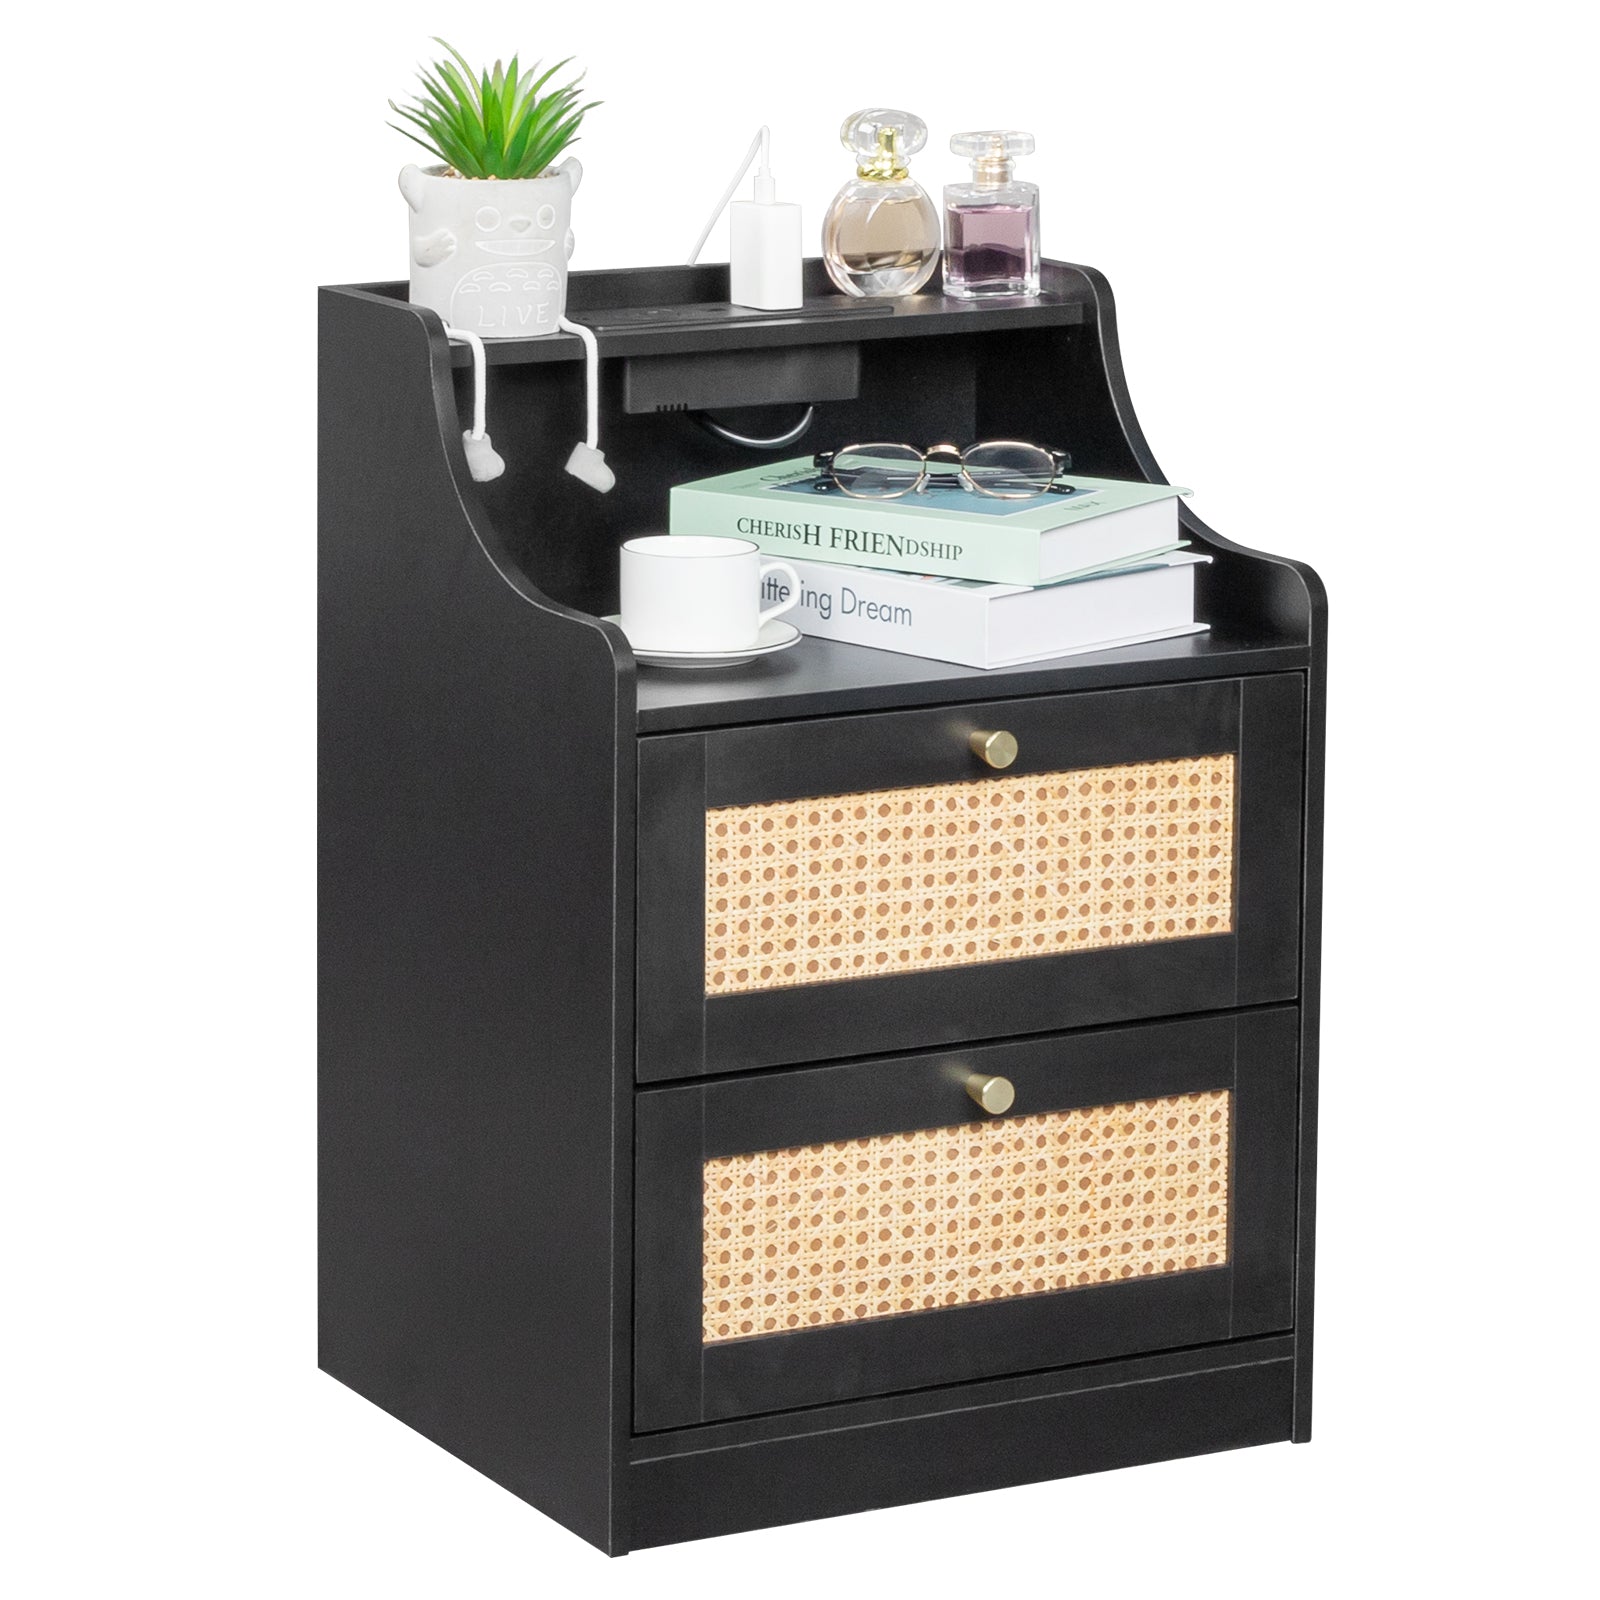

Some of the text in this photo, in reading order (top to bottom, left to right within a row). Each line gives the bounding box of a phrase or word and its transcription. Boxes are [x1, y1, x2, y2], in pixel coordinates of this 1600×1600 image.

[478, 303, 549, 327] LIVE
[737, 517, 963, 561] CHERISH FRIENDSHIP
[761, 576, 912, 626] itteing Dream
